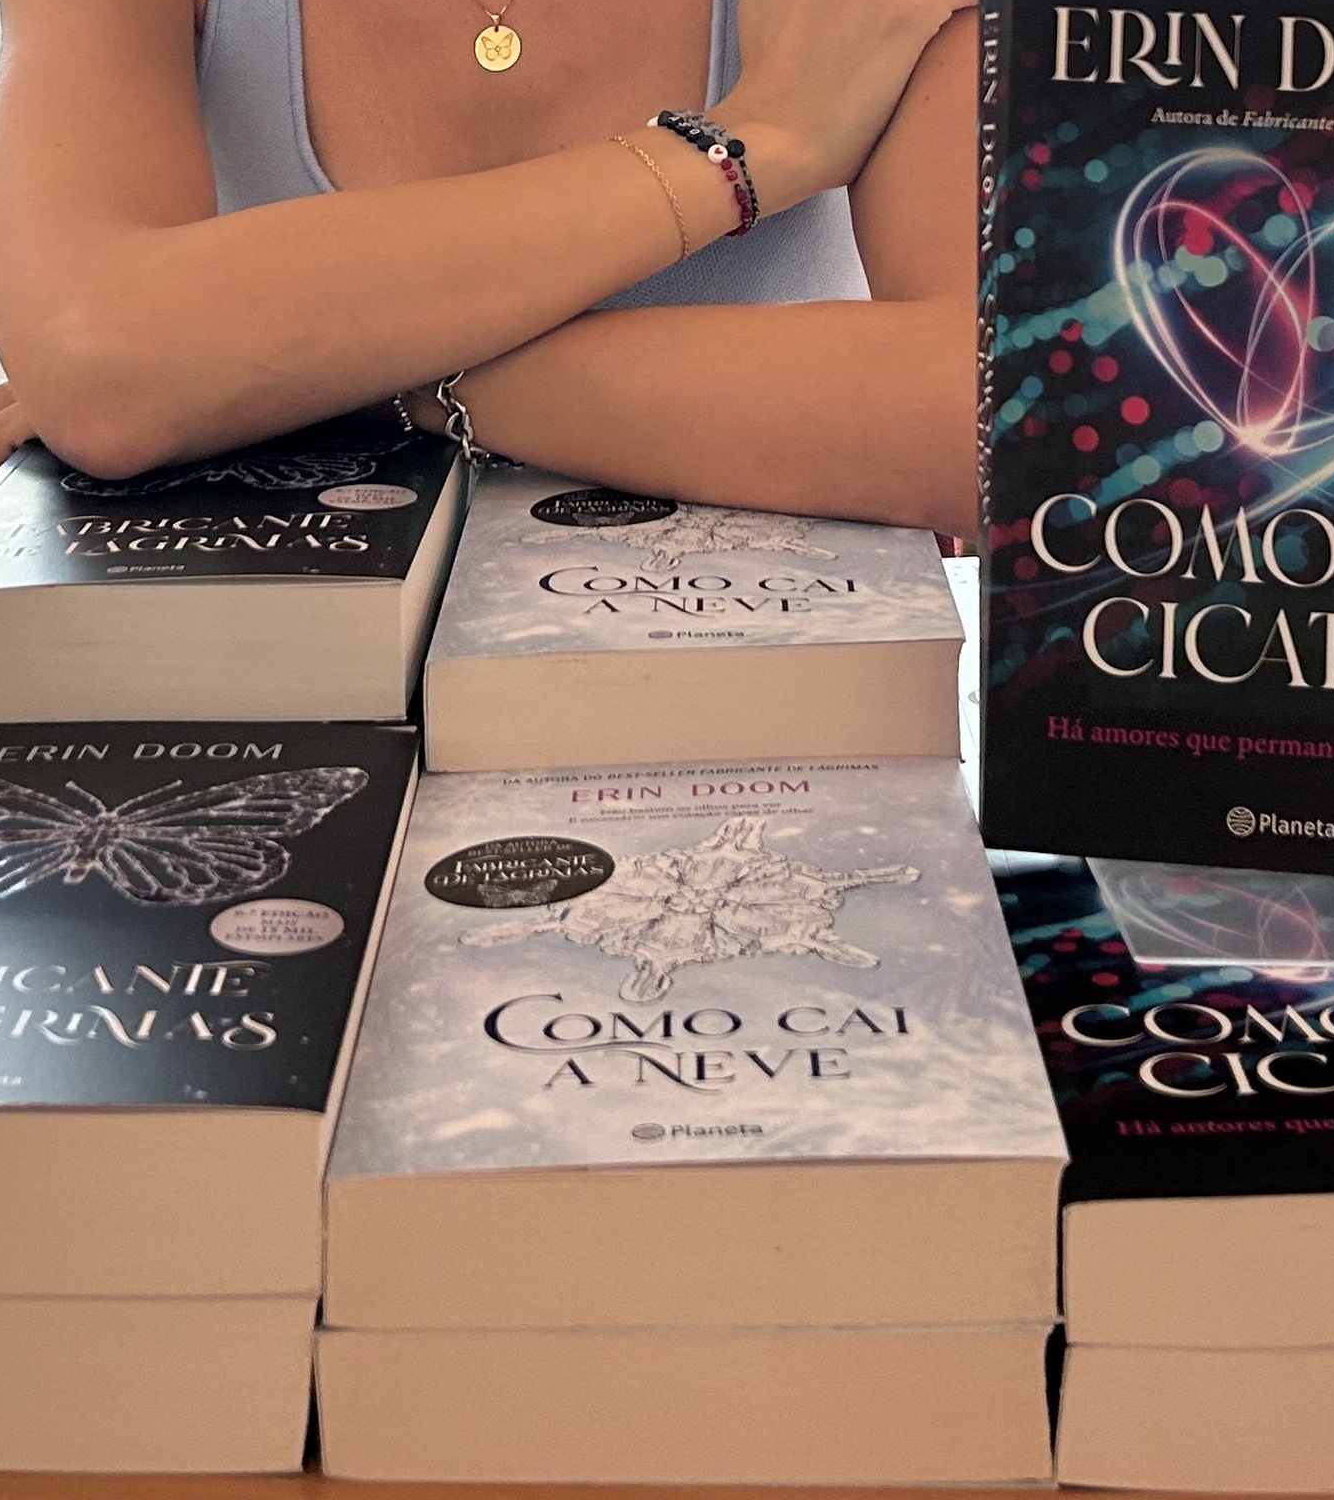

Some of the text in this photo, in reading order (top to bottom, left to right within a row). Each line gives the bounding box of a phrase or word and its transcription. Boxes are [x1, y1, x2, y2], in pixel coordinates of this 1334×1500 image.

[1050, 5, 1246, 91] ERIN
[1150, 105, 1213, 126] Autora
[1215, 110, 1239, 127] de
[538, 566, 857, 596] COMO CAI
[583, 596, 813, 618] A NEVE
[676, 630, 746, 639] Planeta
[1046, 714, 1087, 741] Há
[1089, 724, 1180, 748] amores
[1186, 732, 1233, 758] que
[132, 742, 284, 760] DOOM
[571, 779, 811, 803] ERIN DOOM
[453, 853, 599, 875] FABRICANTE
[483, 992, 913, 1055] COMO CAI
[541, 1047, 853, 1095] A NEVE
[670, 1121, 765, 1138] Planeta
[1117, 1118, 1162, 1137] Há
